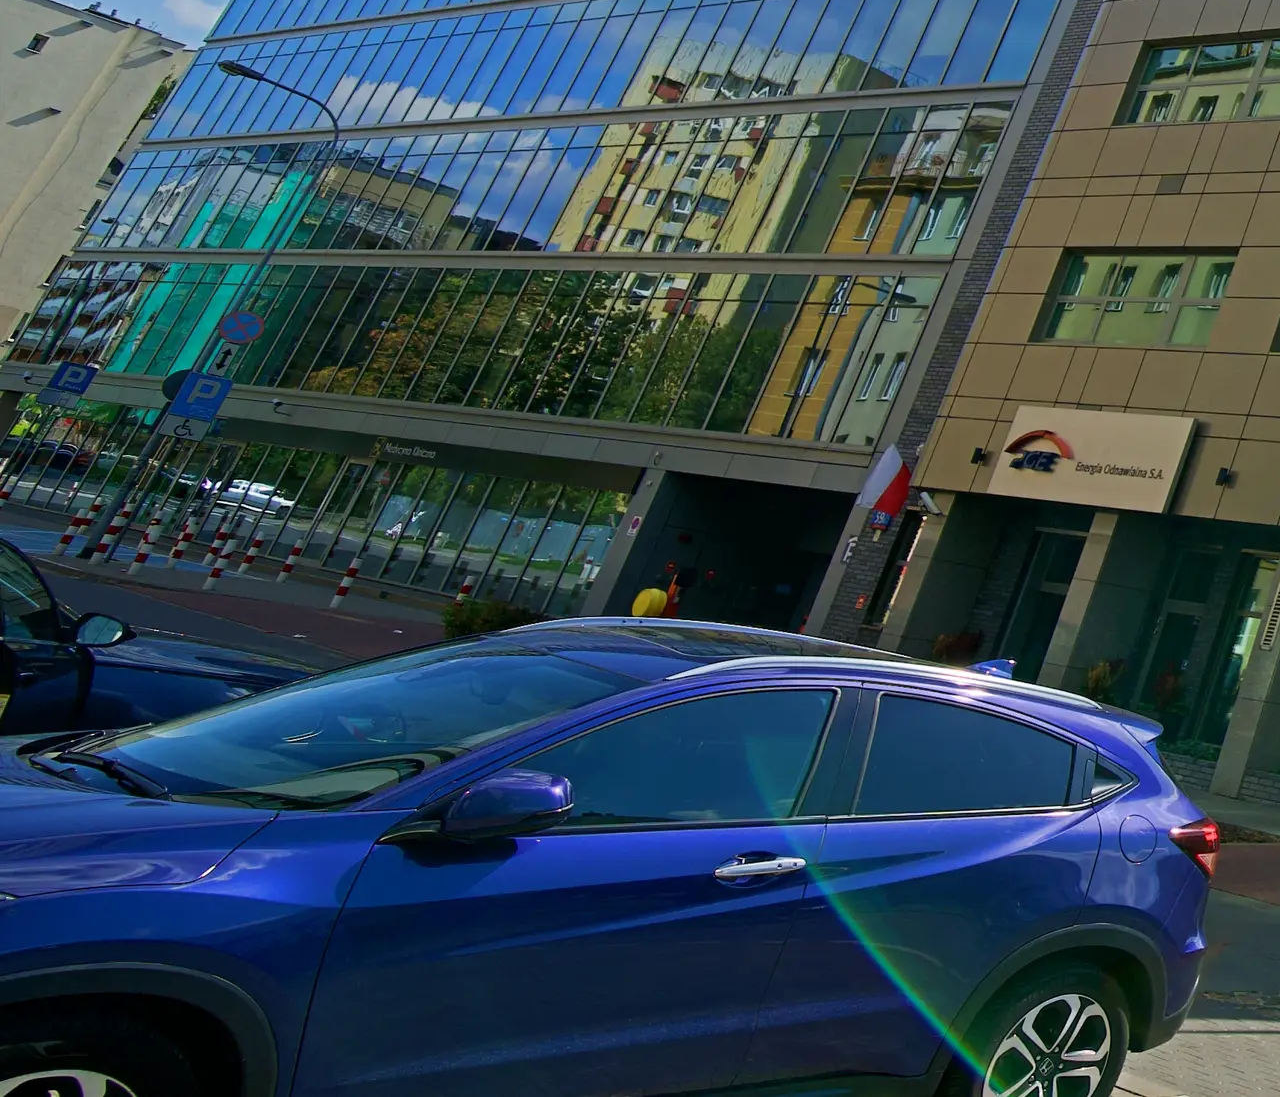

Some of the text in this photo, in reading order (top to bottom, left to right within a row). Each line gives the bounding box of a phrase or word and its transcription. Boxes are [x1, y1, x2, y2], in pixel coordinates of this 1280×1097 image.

[57, 366, 87, 387] P
[187, 378, 221, 404] P
[1075, 462, 1164, 480] Energia Odnawialna S.A.
